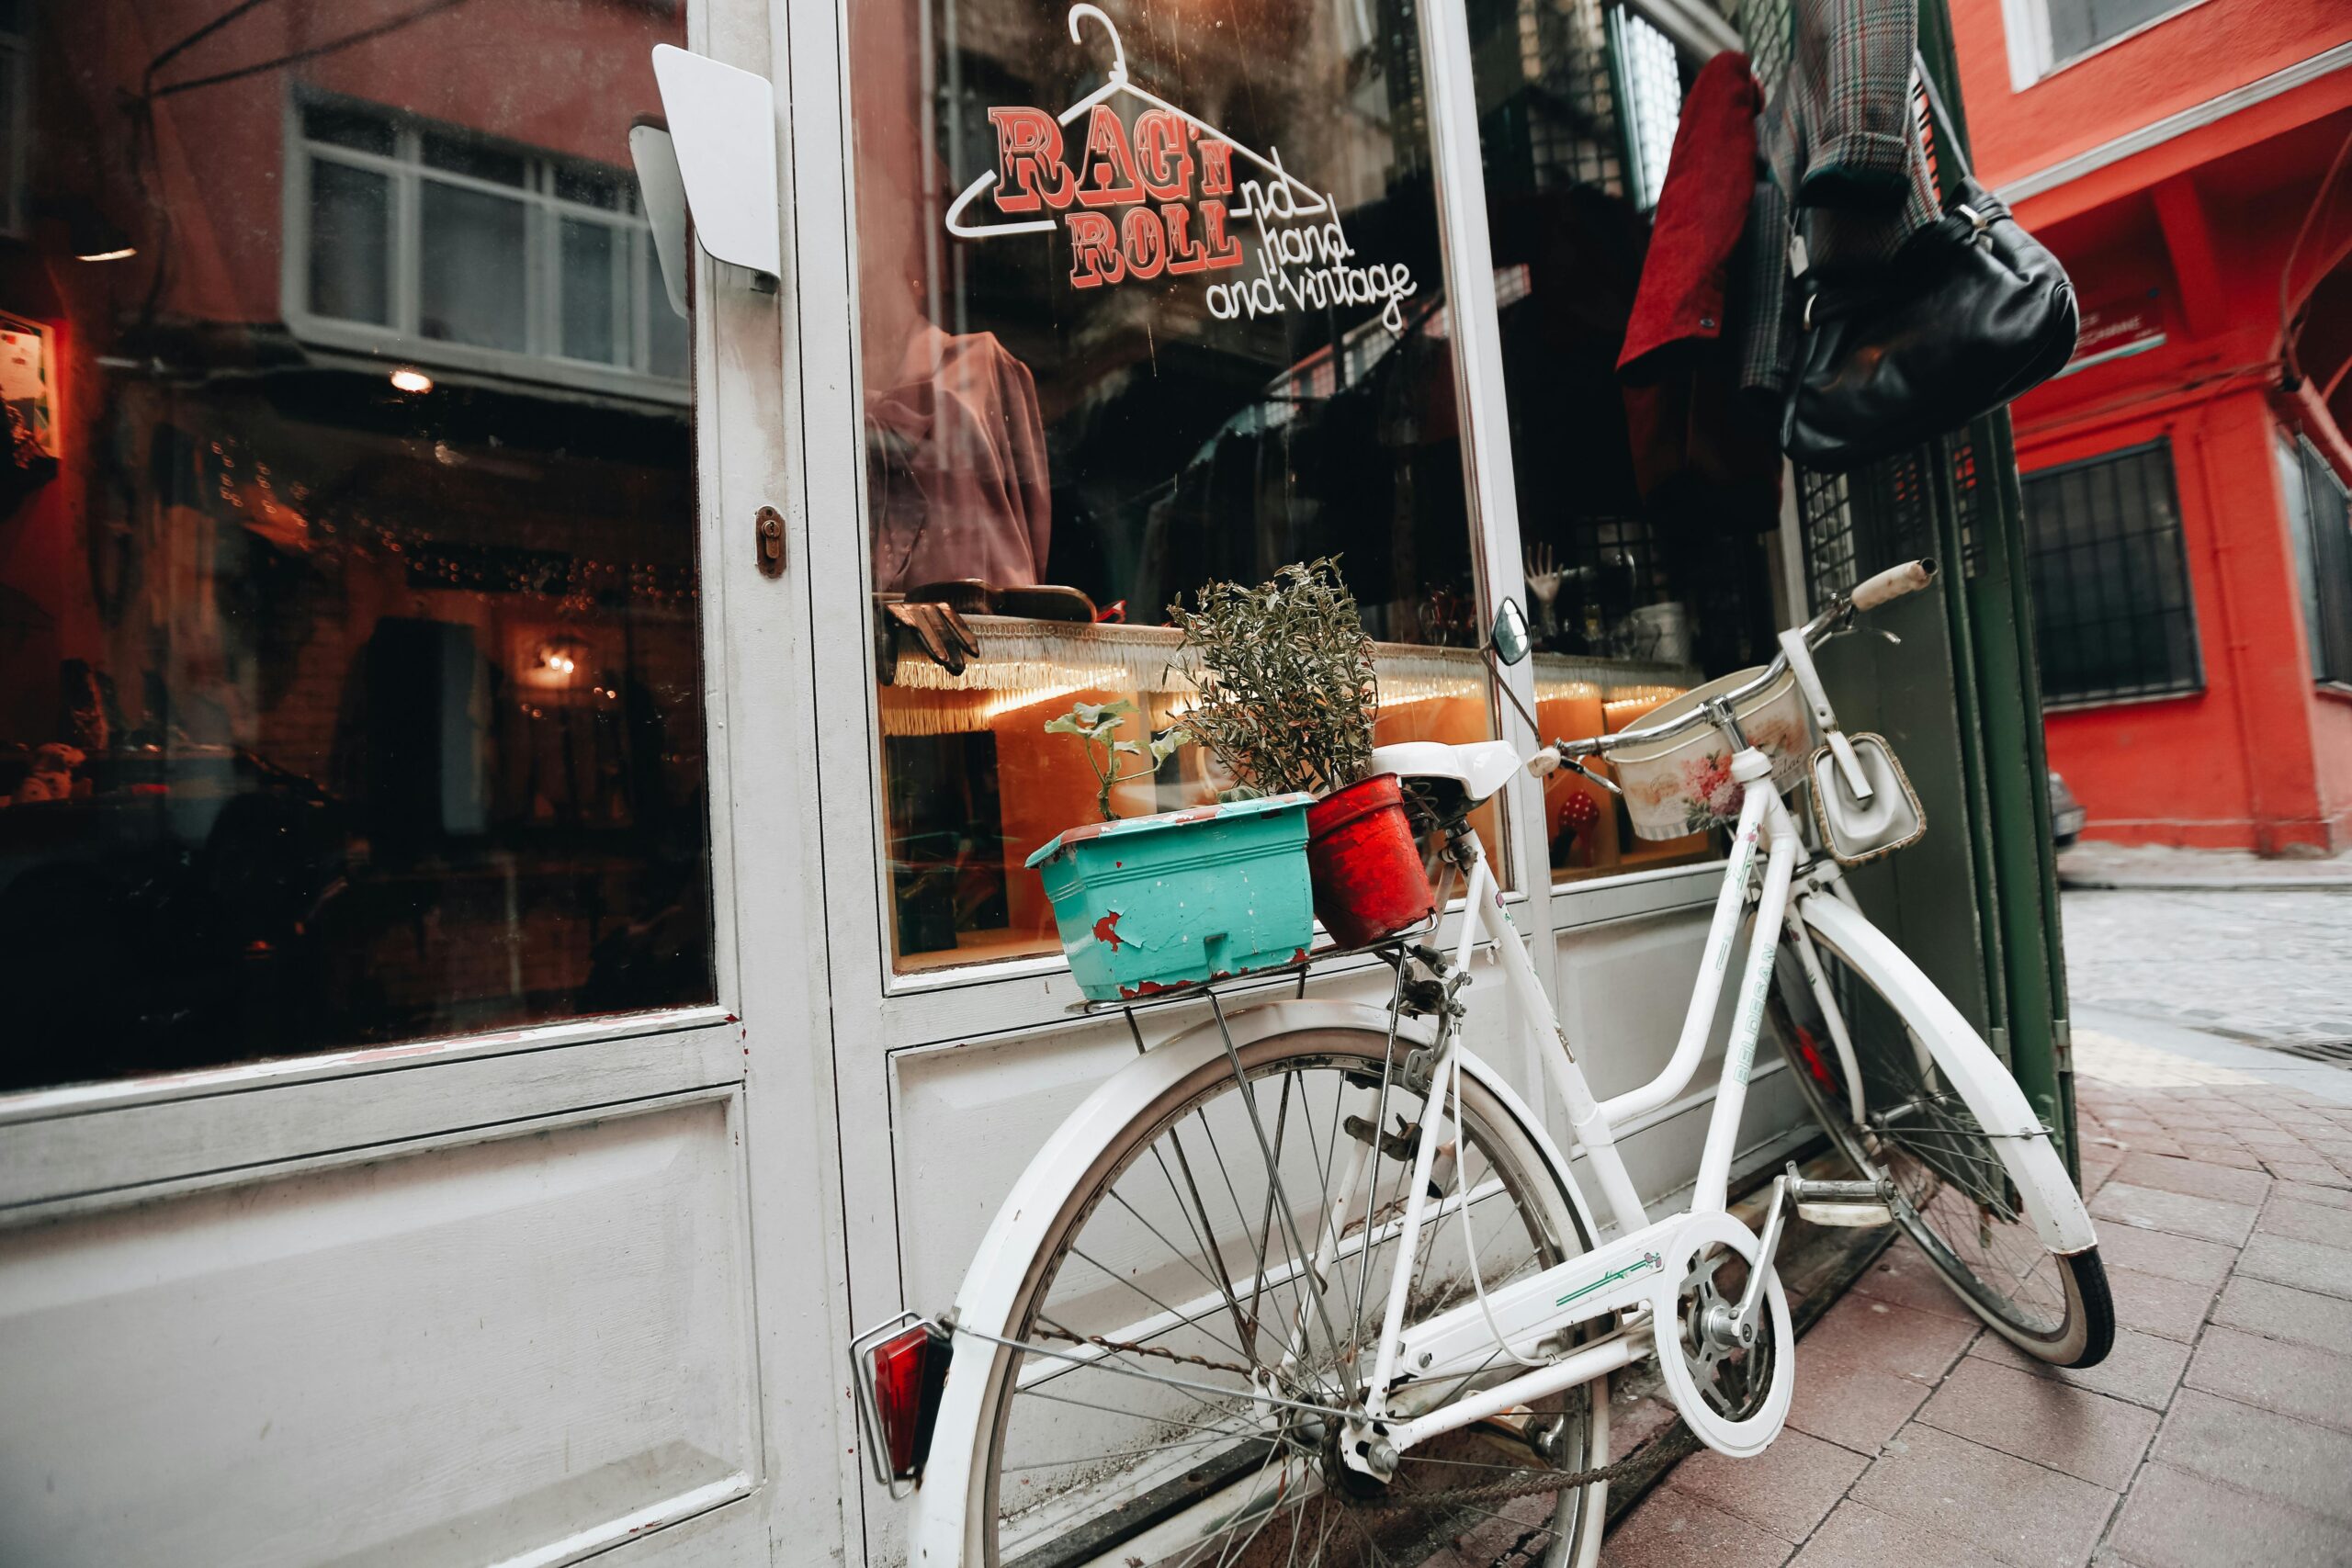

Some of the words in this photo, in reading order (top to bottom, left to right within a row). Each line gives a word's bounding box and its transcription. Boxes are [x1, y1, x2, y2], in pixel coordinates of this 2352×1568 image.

[1065, 199, 1243, 288] ROLL
[1254, 192, 1355, 275] hand
[1205, 247, 1285, 321] and
[1279, 240, 1418, 332] vintage
[1733, 942, 1777, 1088] BELDESAN
